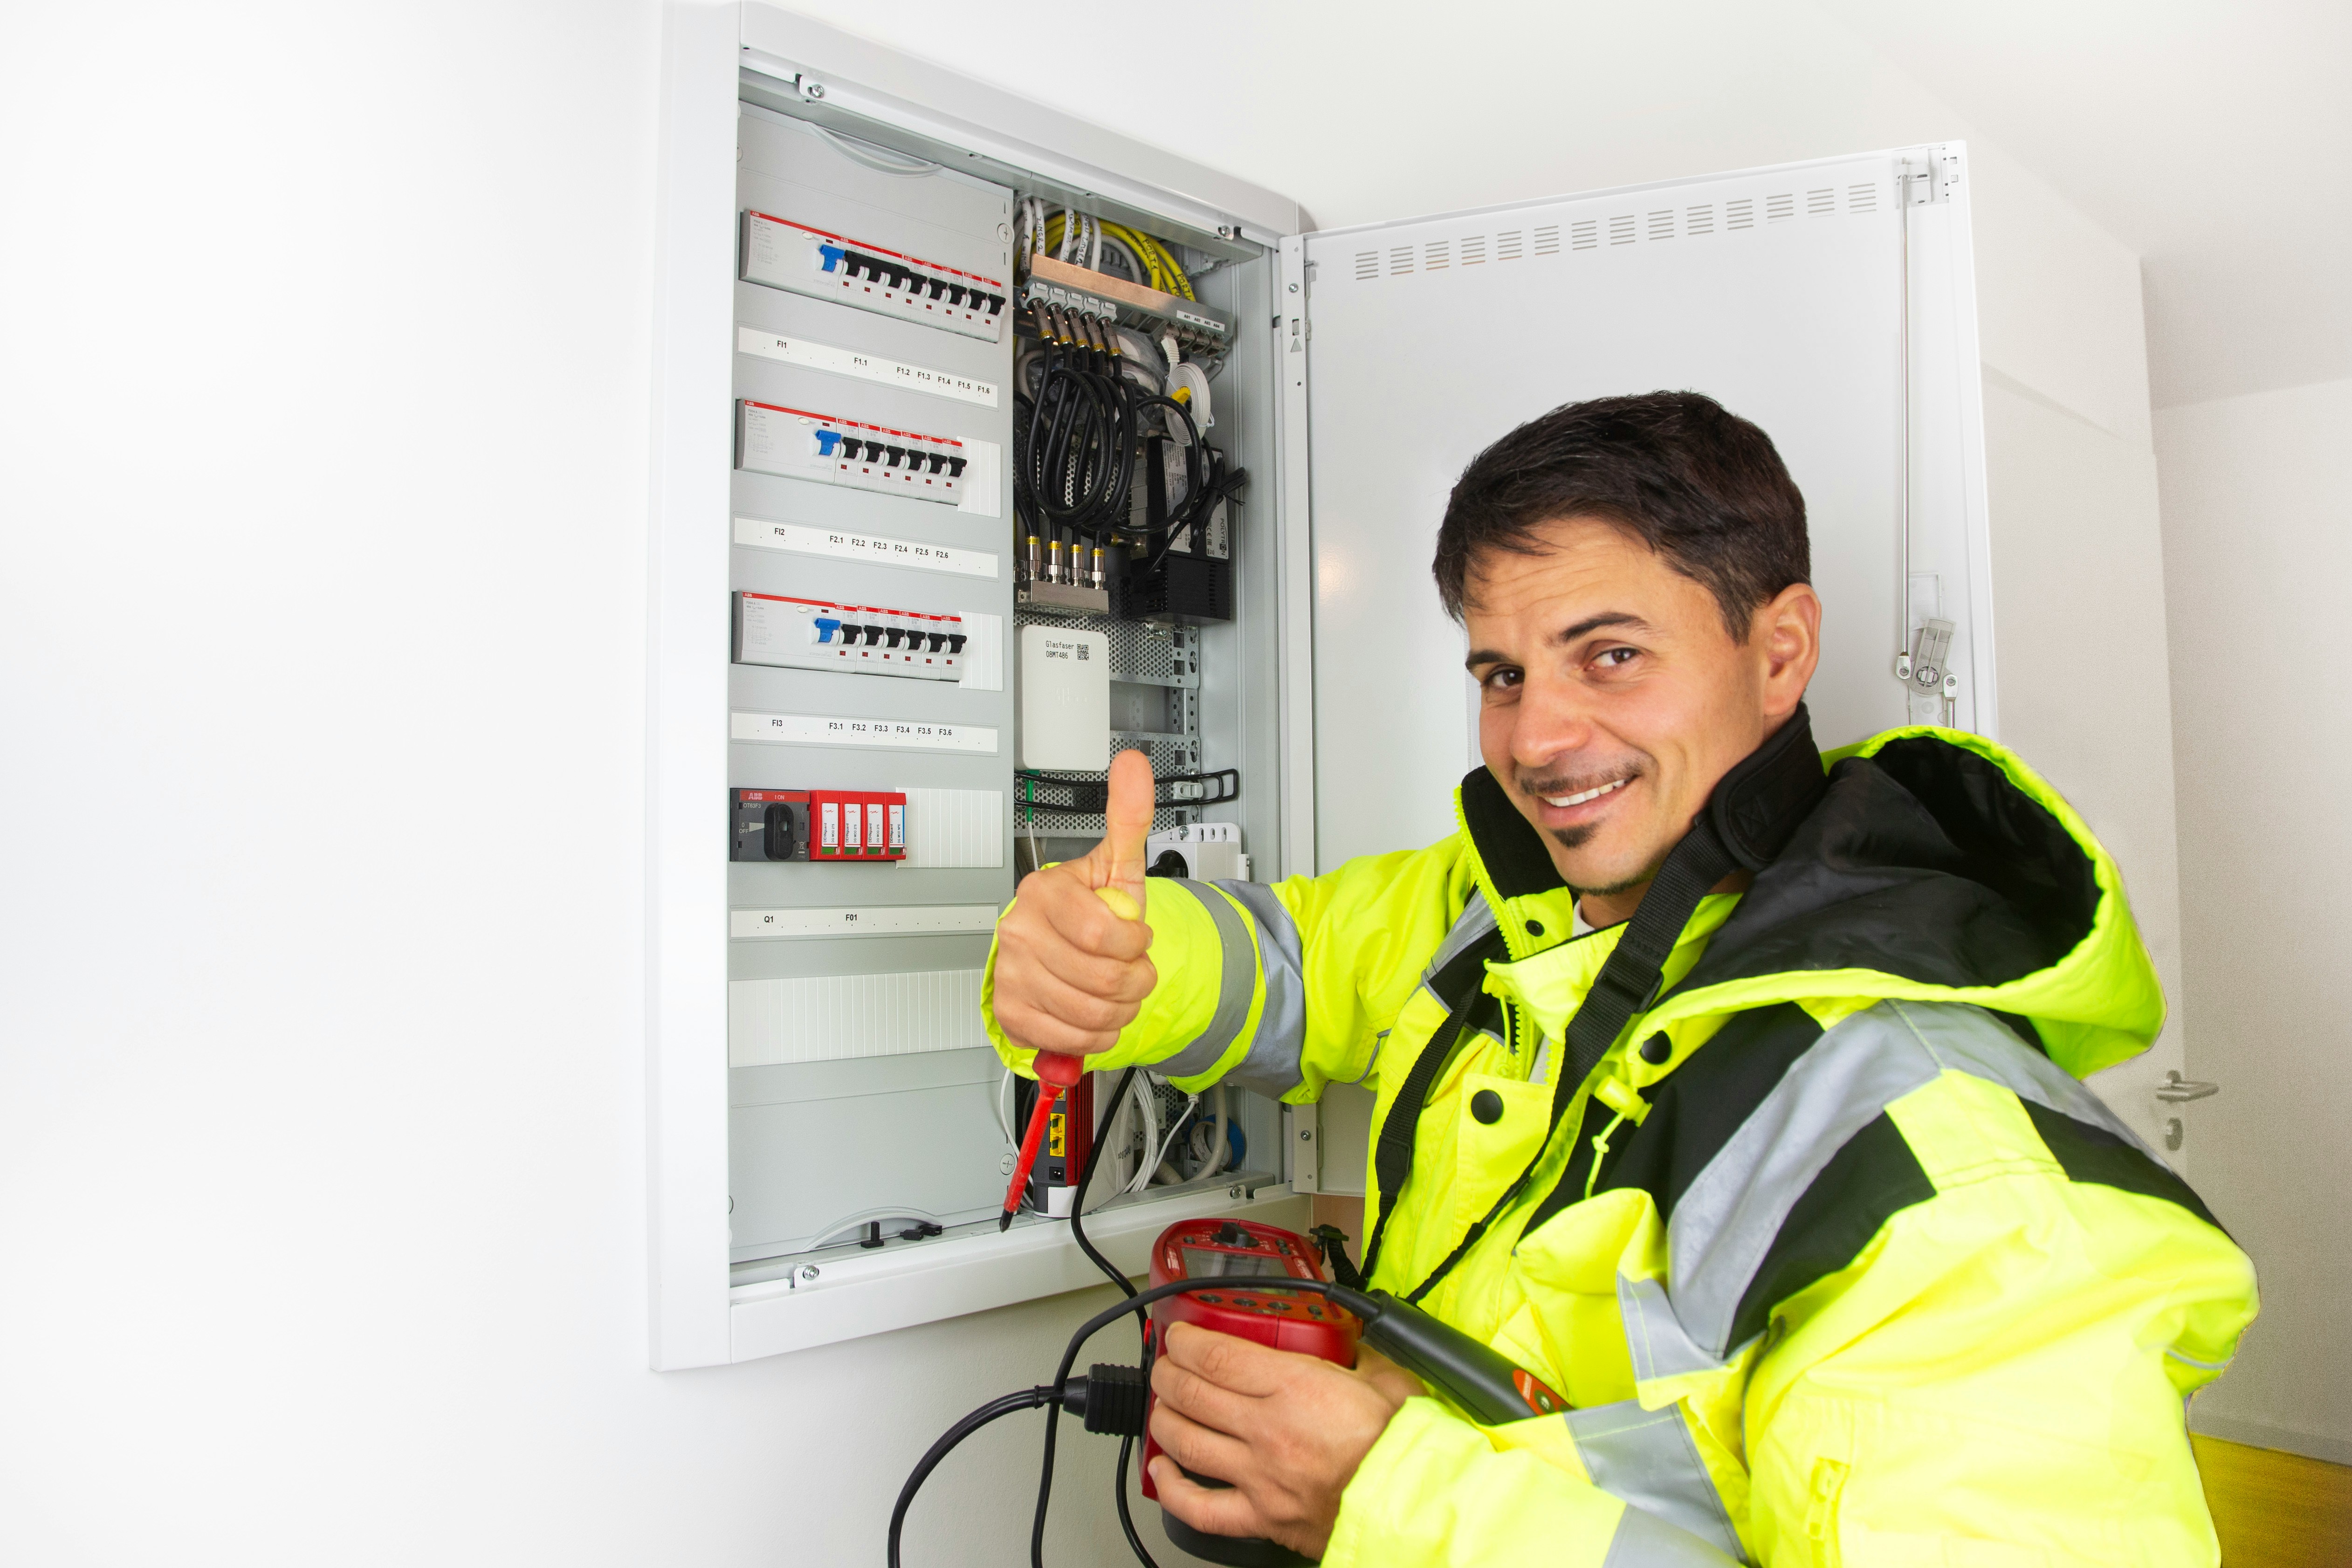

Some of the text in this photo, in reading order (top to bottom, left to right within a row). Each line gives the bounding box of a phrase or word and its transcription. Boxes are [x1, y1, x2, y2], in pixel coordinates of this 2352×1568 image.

[777, 340, 990, 394] FI1 F1.1 F1.2 F1.3 F1.4 F1.5 F1.6
[774, 527, 785, 536] FI2
[830, 535, 843, 543] F2.1
[852, 538, 865, 547] F2.2
[894, 544, 908, 553] F2.4
[915, 547, 928, 556] F2.5
[936, 550, 949, 559] F2.6
[1045, 640, 1074, 649] Glasfaser
[1046, 651, 1068, 659] 08MT486
